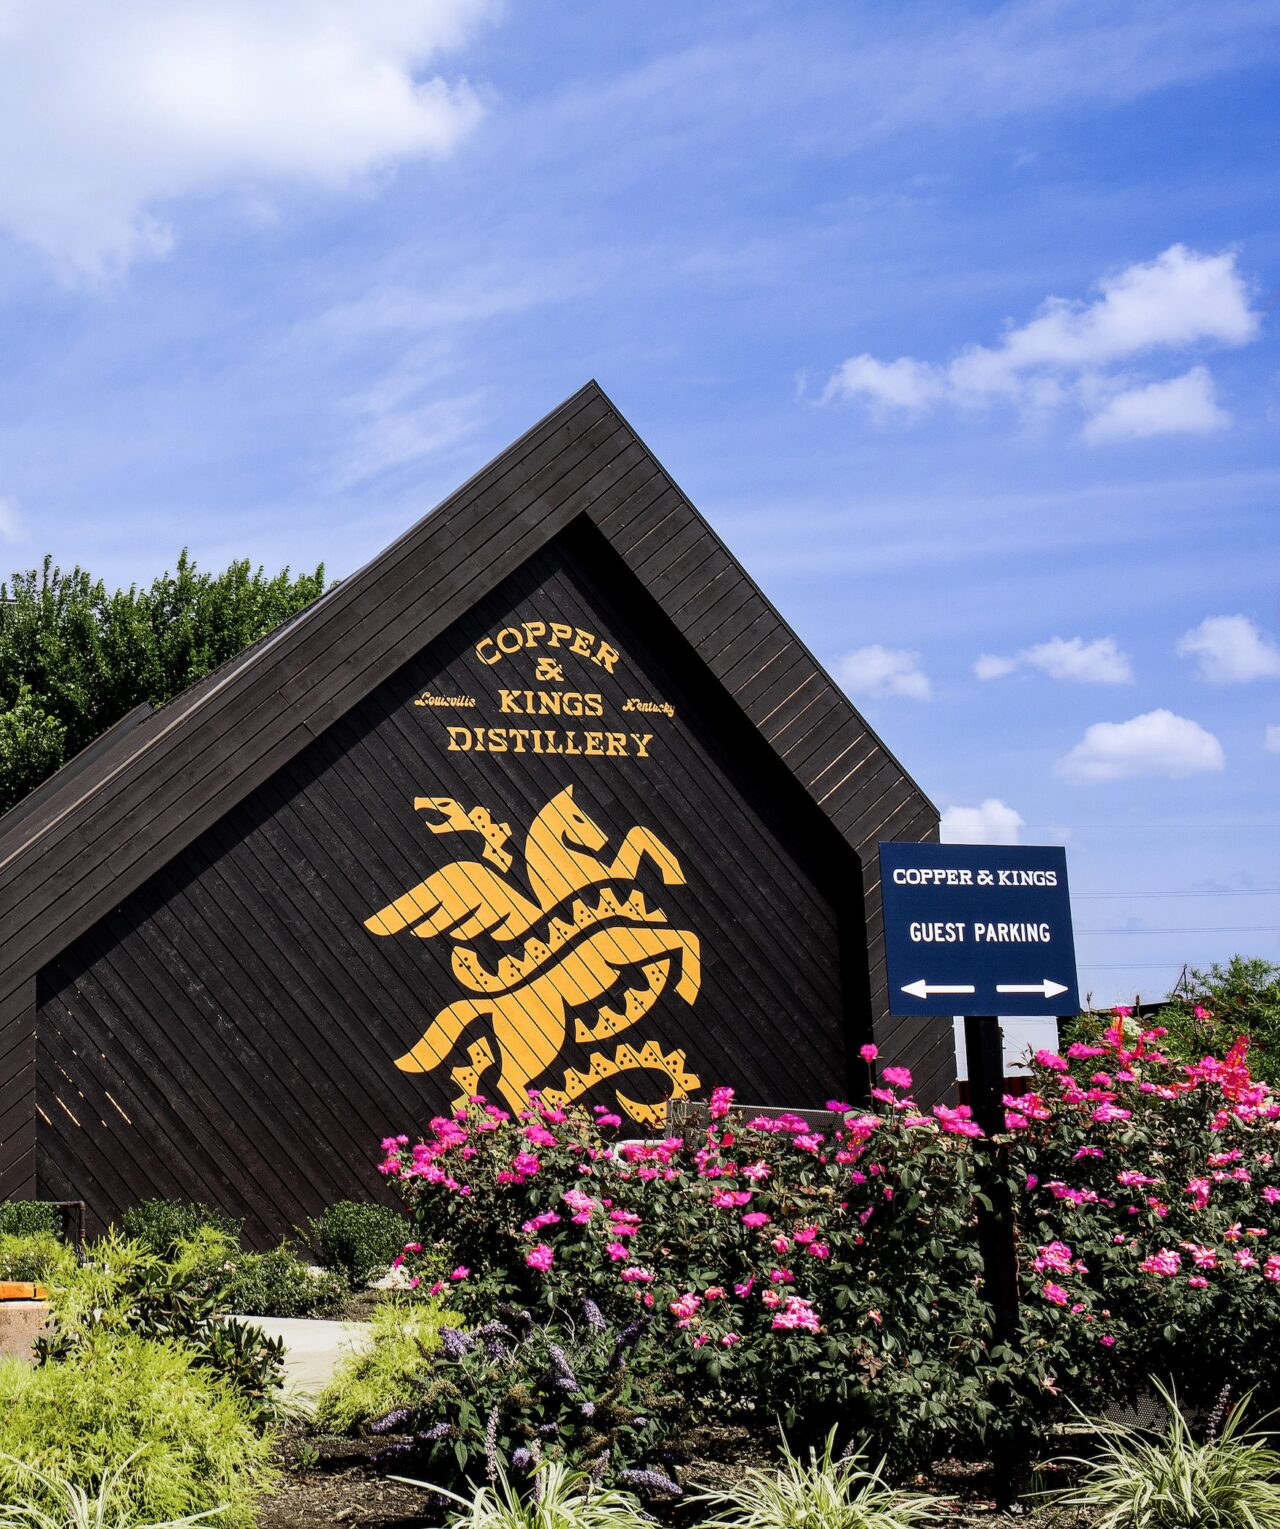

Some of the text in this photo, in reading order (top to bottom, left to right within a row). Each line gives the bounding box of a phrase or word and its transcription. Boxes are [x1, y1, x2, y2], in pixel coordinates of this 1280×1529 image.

[475, 621, 620, 674] COPPER
[535, 657, 564, 682] &
[414, 691, 476, 708] Louisville
[498, 689, 604, 717] KINGS
[622, 698, 675, 718] Kentucky
[447, 726, 654, 758] DISTILLERY
[892, 868, 1058, 887] COPPER & KINGS
[909, 922, 1051, 943] GUEST PARKING
